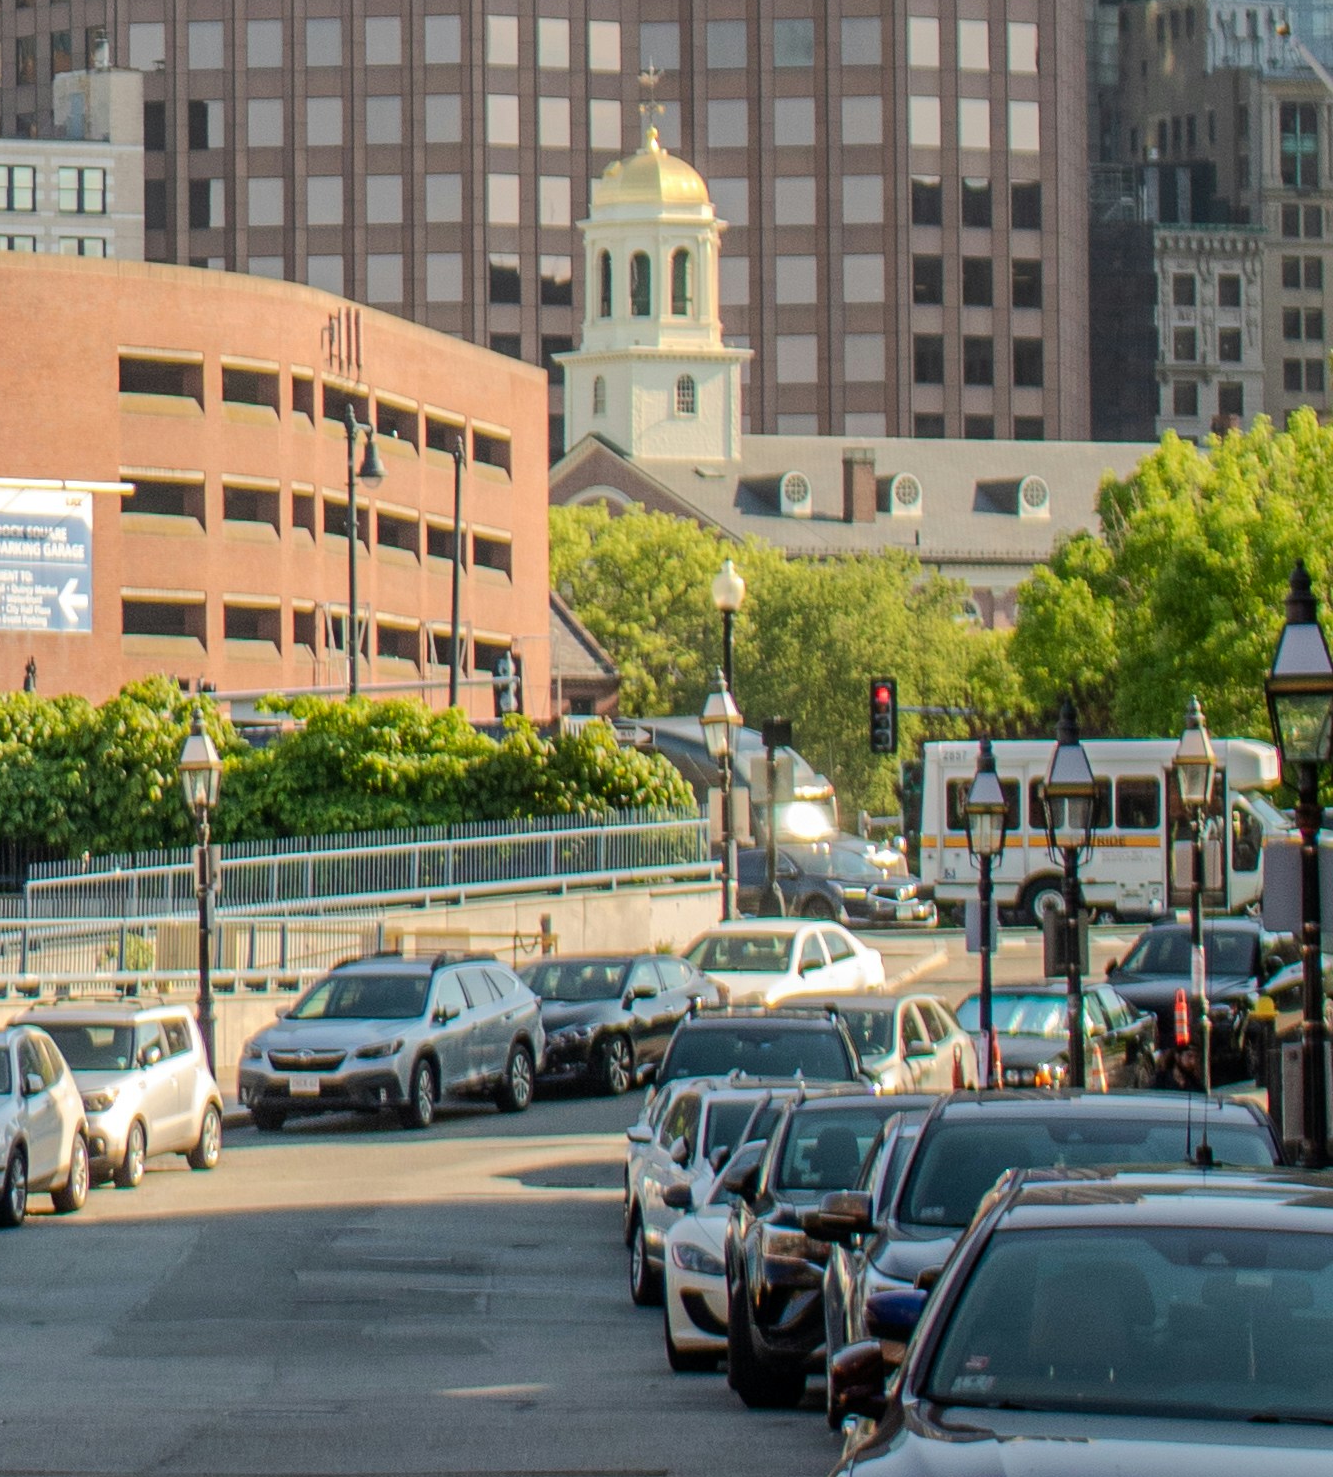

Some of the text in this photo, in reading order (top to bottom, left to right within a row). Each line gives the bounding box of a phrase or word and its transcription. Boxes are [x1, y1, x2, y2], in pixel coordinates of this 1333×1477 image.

[27, 526, 67, 541] SQUARE
[43, 543, 84, 558] GARAGE
[1097, 835, 1126, 847] RIDE
